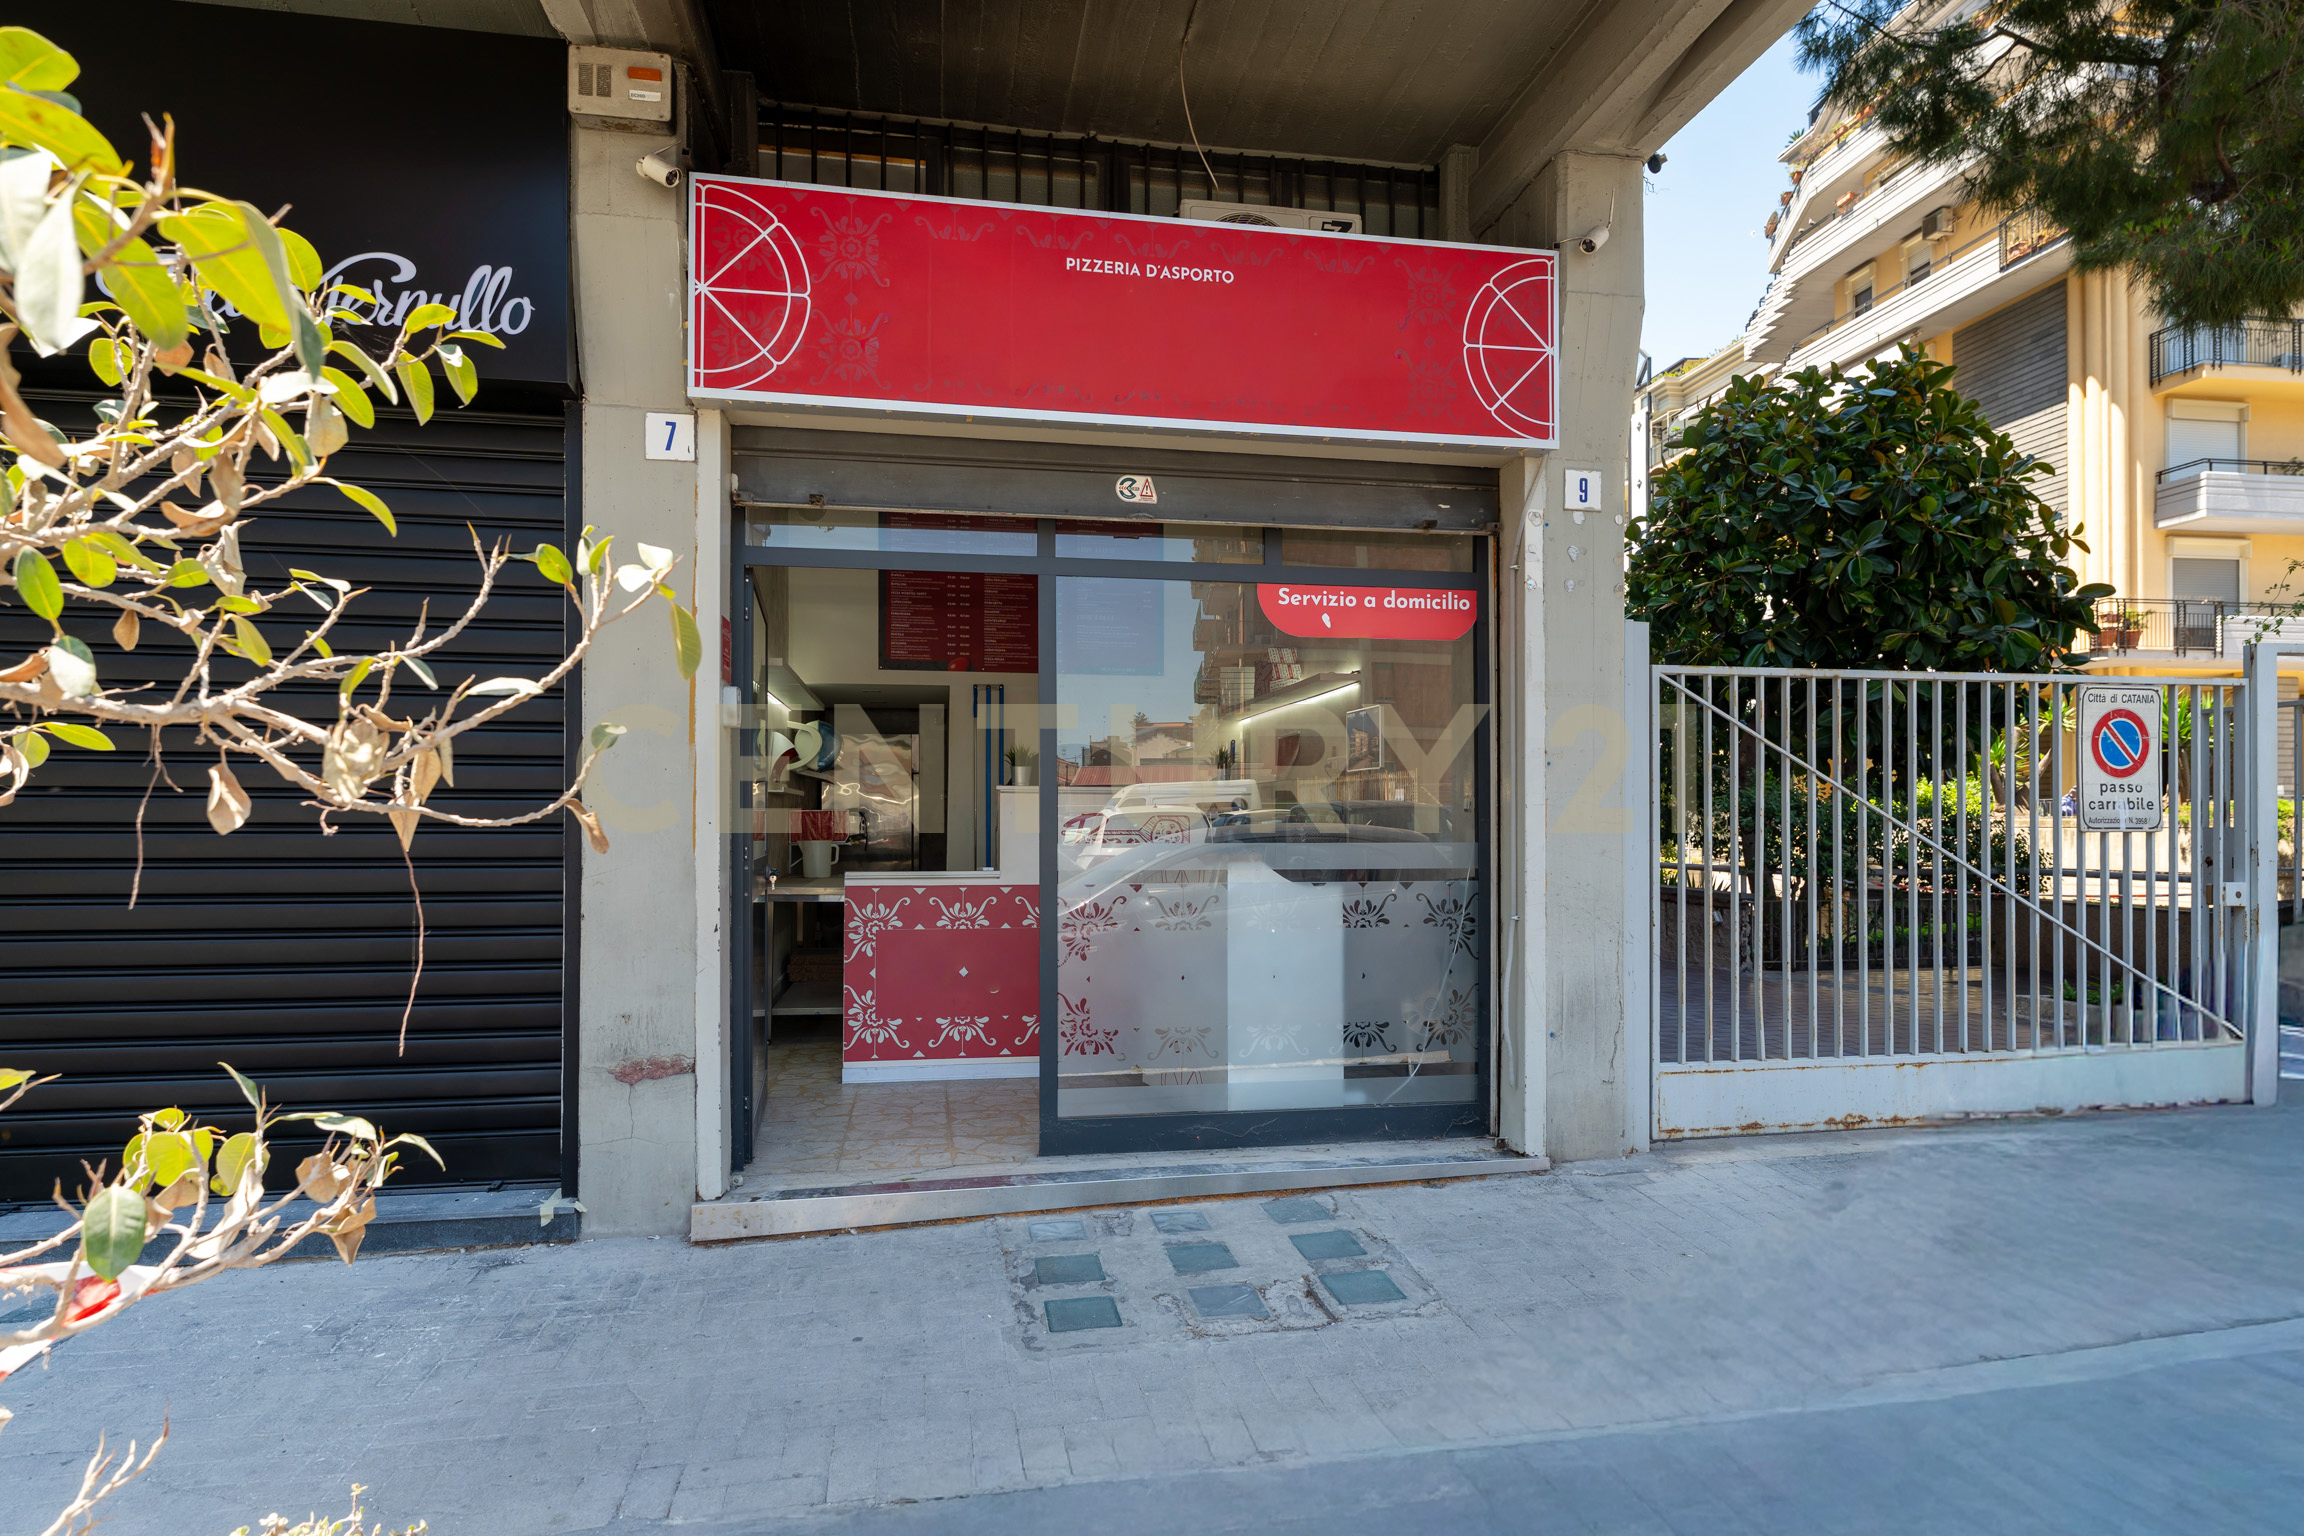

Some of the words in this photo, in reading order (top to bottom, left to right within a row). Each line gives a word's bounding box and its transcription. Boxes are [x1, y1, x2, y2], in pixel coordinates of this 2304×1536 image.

[1066, 257, 1141, 277] PIZZERIA
[1146, 263, 1235, 284] D'ASPORTO
[665, 421, 677, 451] 7
[1579, 477, 1588, 503] 9
[1278, 587, 1357, 608] Servizio
[1364, 595, 1376, 608] a
[1383, 590, 1470, 611] domicilio
[2088, 692, 2106, 703] Città
[2110, 693, 2118, 703] di
[2121, 693, 2155, 704] CATANIA
[2100, 783, 2143, 796] passo
